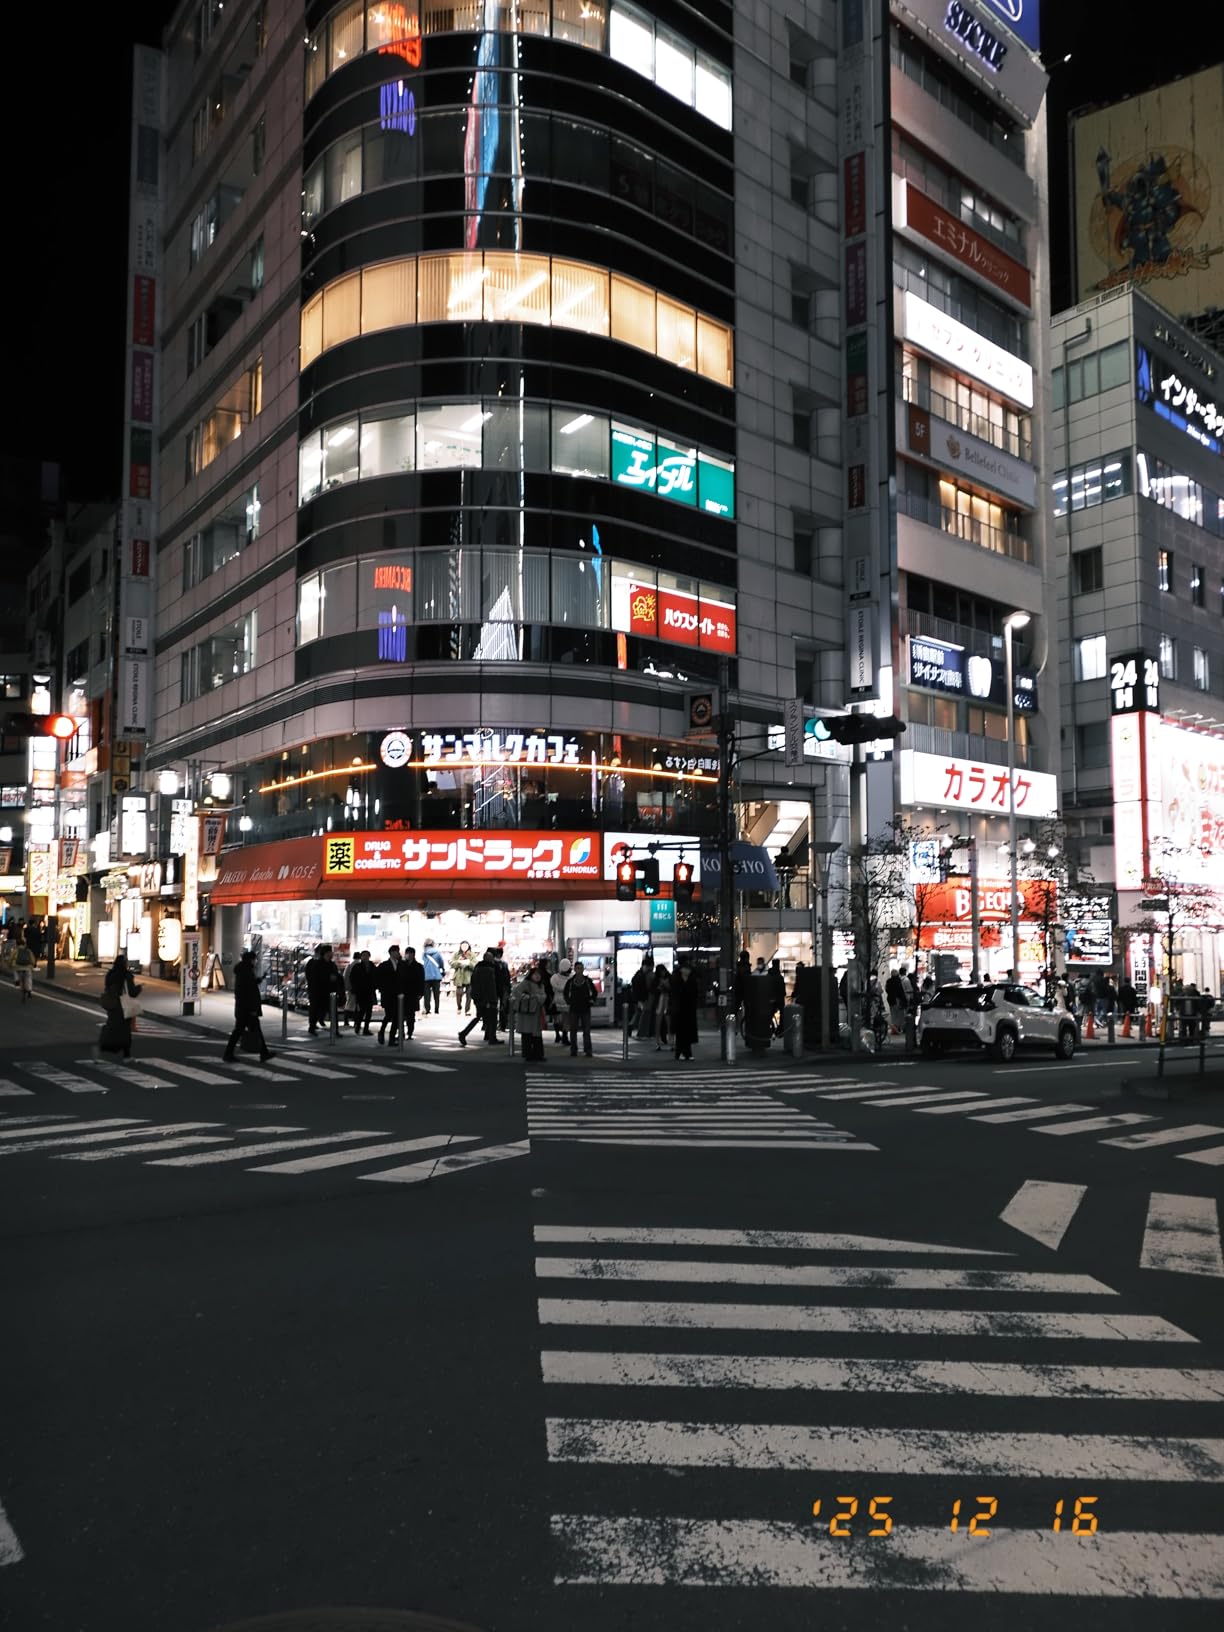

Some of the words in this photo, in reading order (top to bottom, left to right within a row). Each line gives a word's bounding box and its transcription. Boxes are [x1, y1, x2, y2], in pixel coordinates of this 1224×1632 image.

[914, 421, 926, 438] 5F
[618, 449, 697, 495] エイブル
[664, 608, 715, 635] ハウスメイト
[858, 661, 866, 684] CLINIC
[1111, 659, 1137, 690] 24
[1144, 658, 1159, 687] 24
[1115, 686, 1134, 709] H
[421, 735, 580, 764] サンマルクカフェ
[944, 763, 1032, 808] カラオケ
[329, 841, 351, 871] 薬
[364, 841, 391, 851] DRUG
[373, 851, 382, 860] &
[402, 839, 563, 870] サンドラッグ
[291, 864, 317, 879] KOSÉ
[355, 859, 401, 869] COSMETIC
[562, 865, 598, 874] SUNDRUG
[955, 932, 973, 944] ECH
